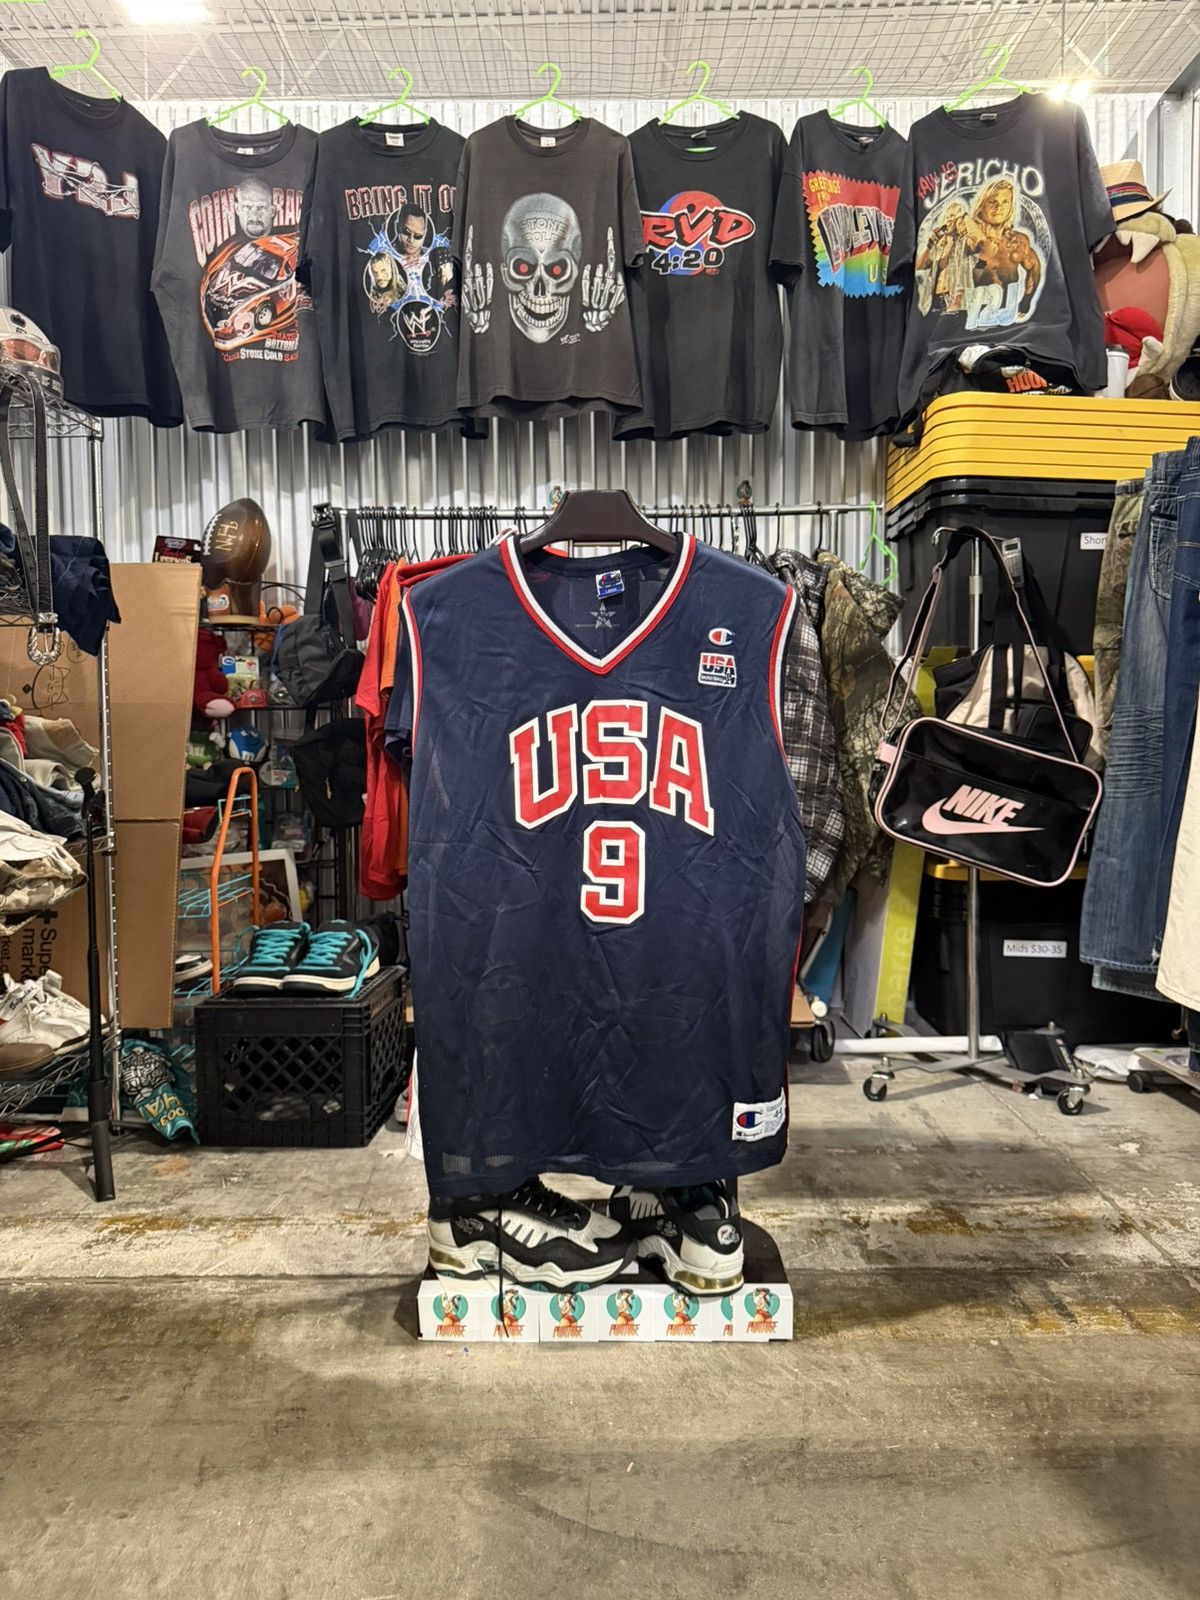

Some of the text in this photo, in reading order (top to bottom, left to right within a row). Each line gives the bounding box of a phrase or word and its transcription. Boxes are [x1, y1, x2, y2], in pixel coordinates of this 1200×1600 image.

[345, 185, 408, 220] BRING
[413, 184, 433, 215] IT
[922, 157, 1044, 209] JERICHO
[640, 205, 756, 253] RVD
[652, 246, 725, 275] 4:20
[702, 654, 735, 674] USA
[509, 698, 715, 837] USA
[942, 783, 1026, 827] NIKE
[580, 820, 646, 925] 9
